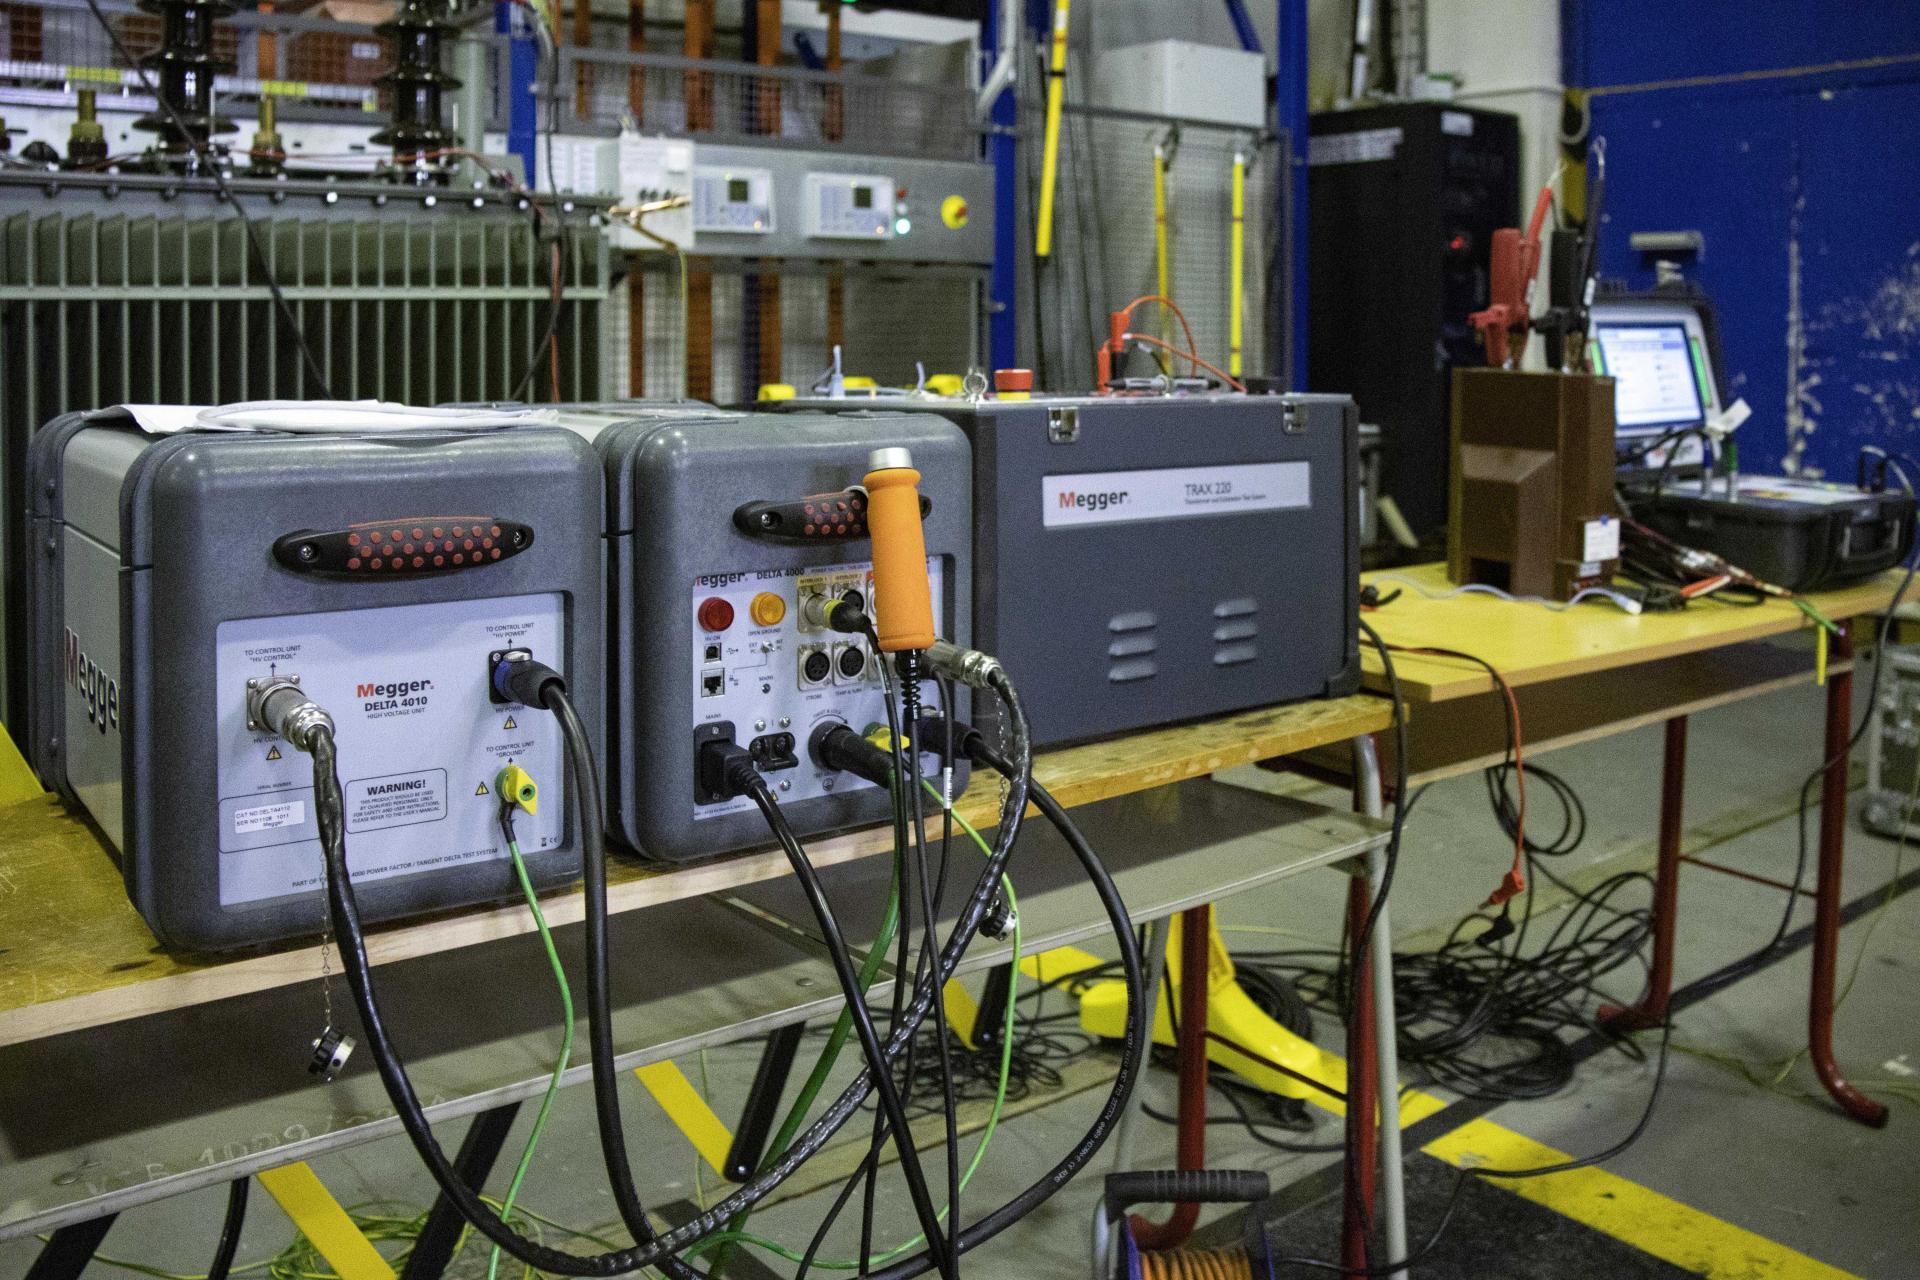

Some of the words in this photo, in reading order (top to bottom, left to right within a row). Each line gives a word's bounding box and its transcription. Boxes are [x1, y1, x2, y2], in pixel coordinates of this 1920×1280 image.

[1185, 484, 1212, 496] TRAX
[1215, 482, 1232, 494] 220
[1059, 491, 1128, 511] Megger
[757, 569, 782, 580] DELTA
[785, 568, 805, 577] 4000
[256, 647, 285, 655] CONTROL
[65, 626, 119, 735] Megge
[357, 680, 431, 698] Megger
[365, 700, 398, 712] DELTA
[401, 697, 428, 707] 4010
[384, 710, 410, 718] VOLTAGE
[495, 743, 521, 751] CONTROL
[367, 779, 426, 796] WARNING!
[367, 866, 388, 877] POWER
[390, 862, 412, 871] FACTOR
[417, 857, 443, 867] TANGENT
[444, 854, 462, 863] DELTA
[463, 852, 475, 860] TEST
